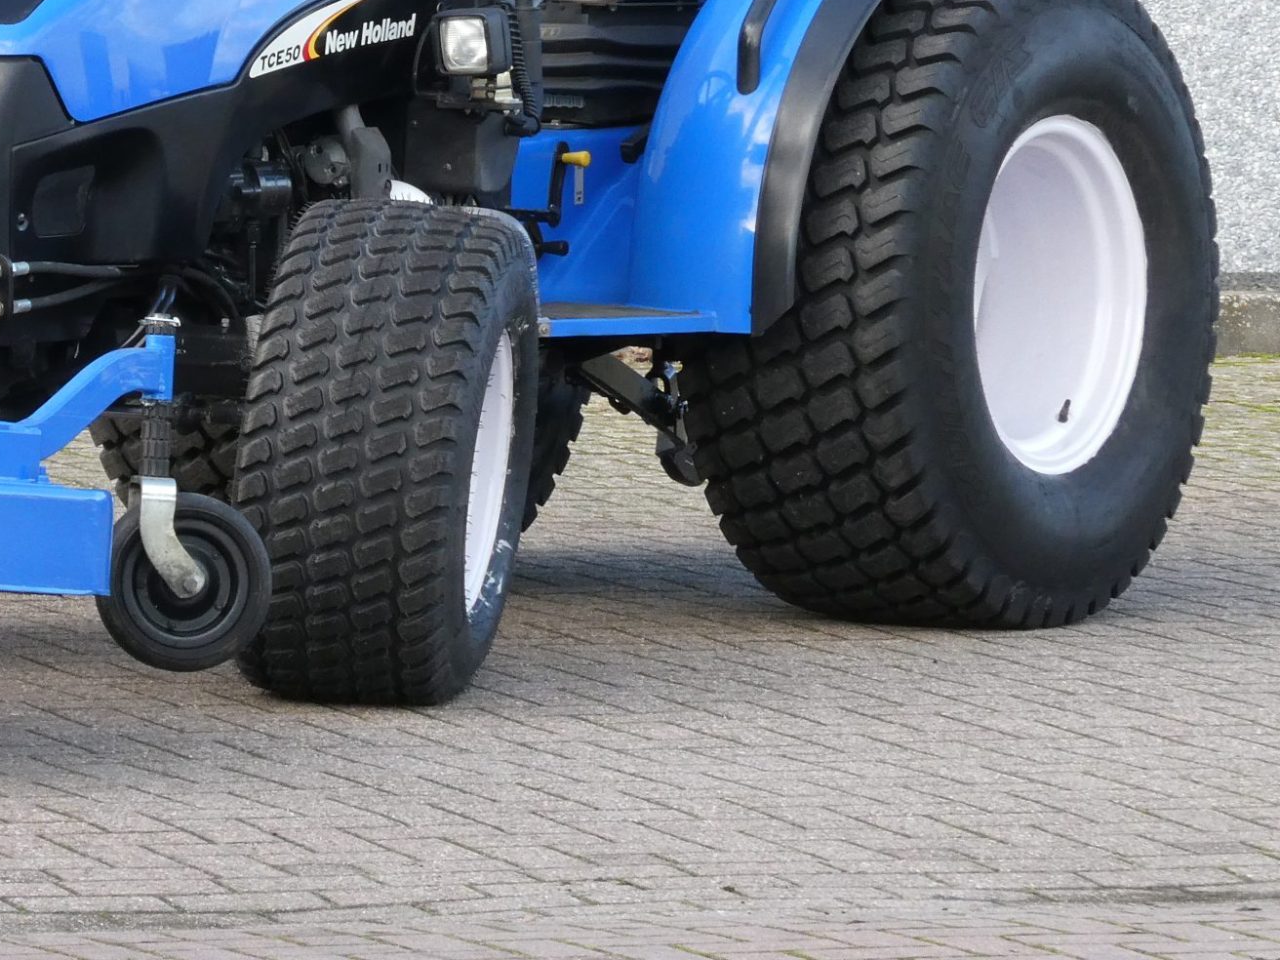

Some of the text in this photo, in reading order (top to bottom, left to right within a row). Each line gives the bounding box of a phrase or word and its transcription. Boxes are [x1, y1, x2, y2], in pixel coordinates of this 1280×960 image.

[324, 13, 417, 55] New Holland
[260, 44, 301, 71] TCE50
